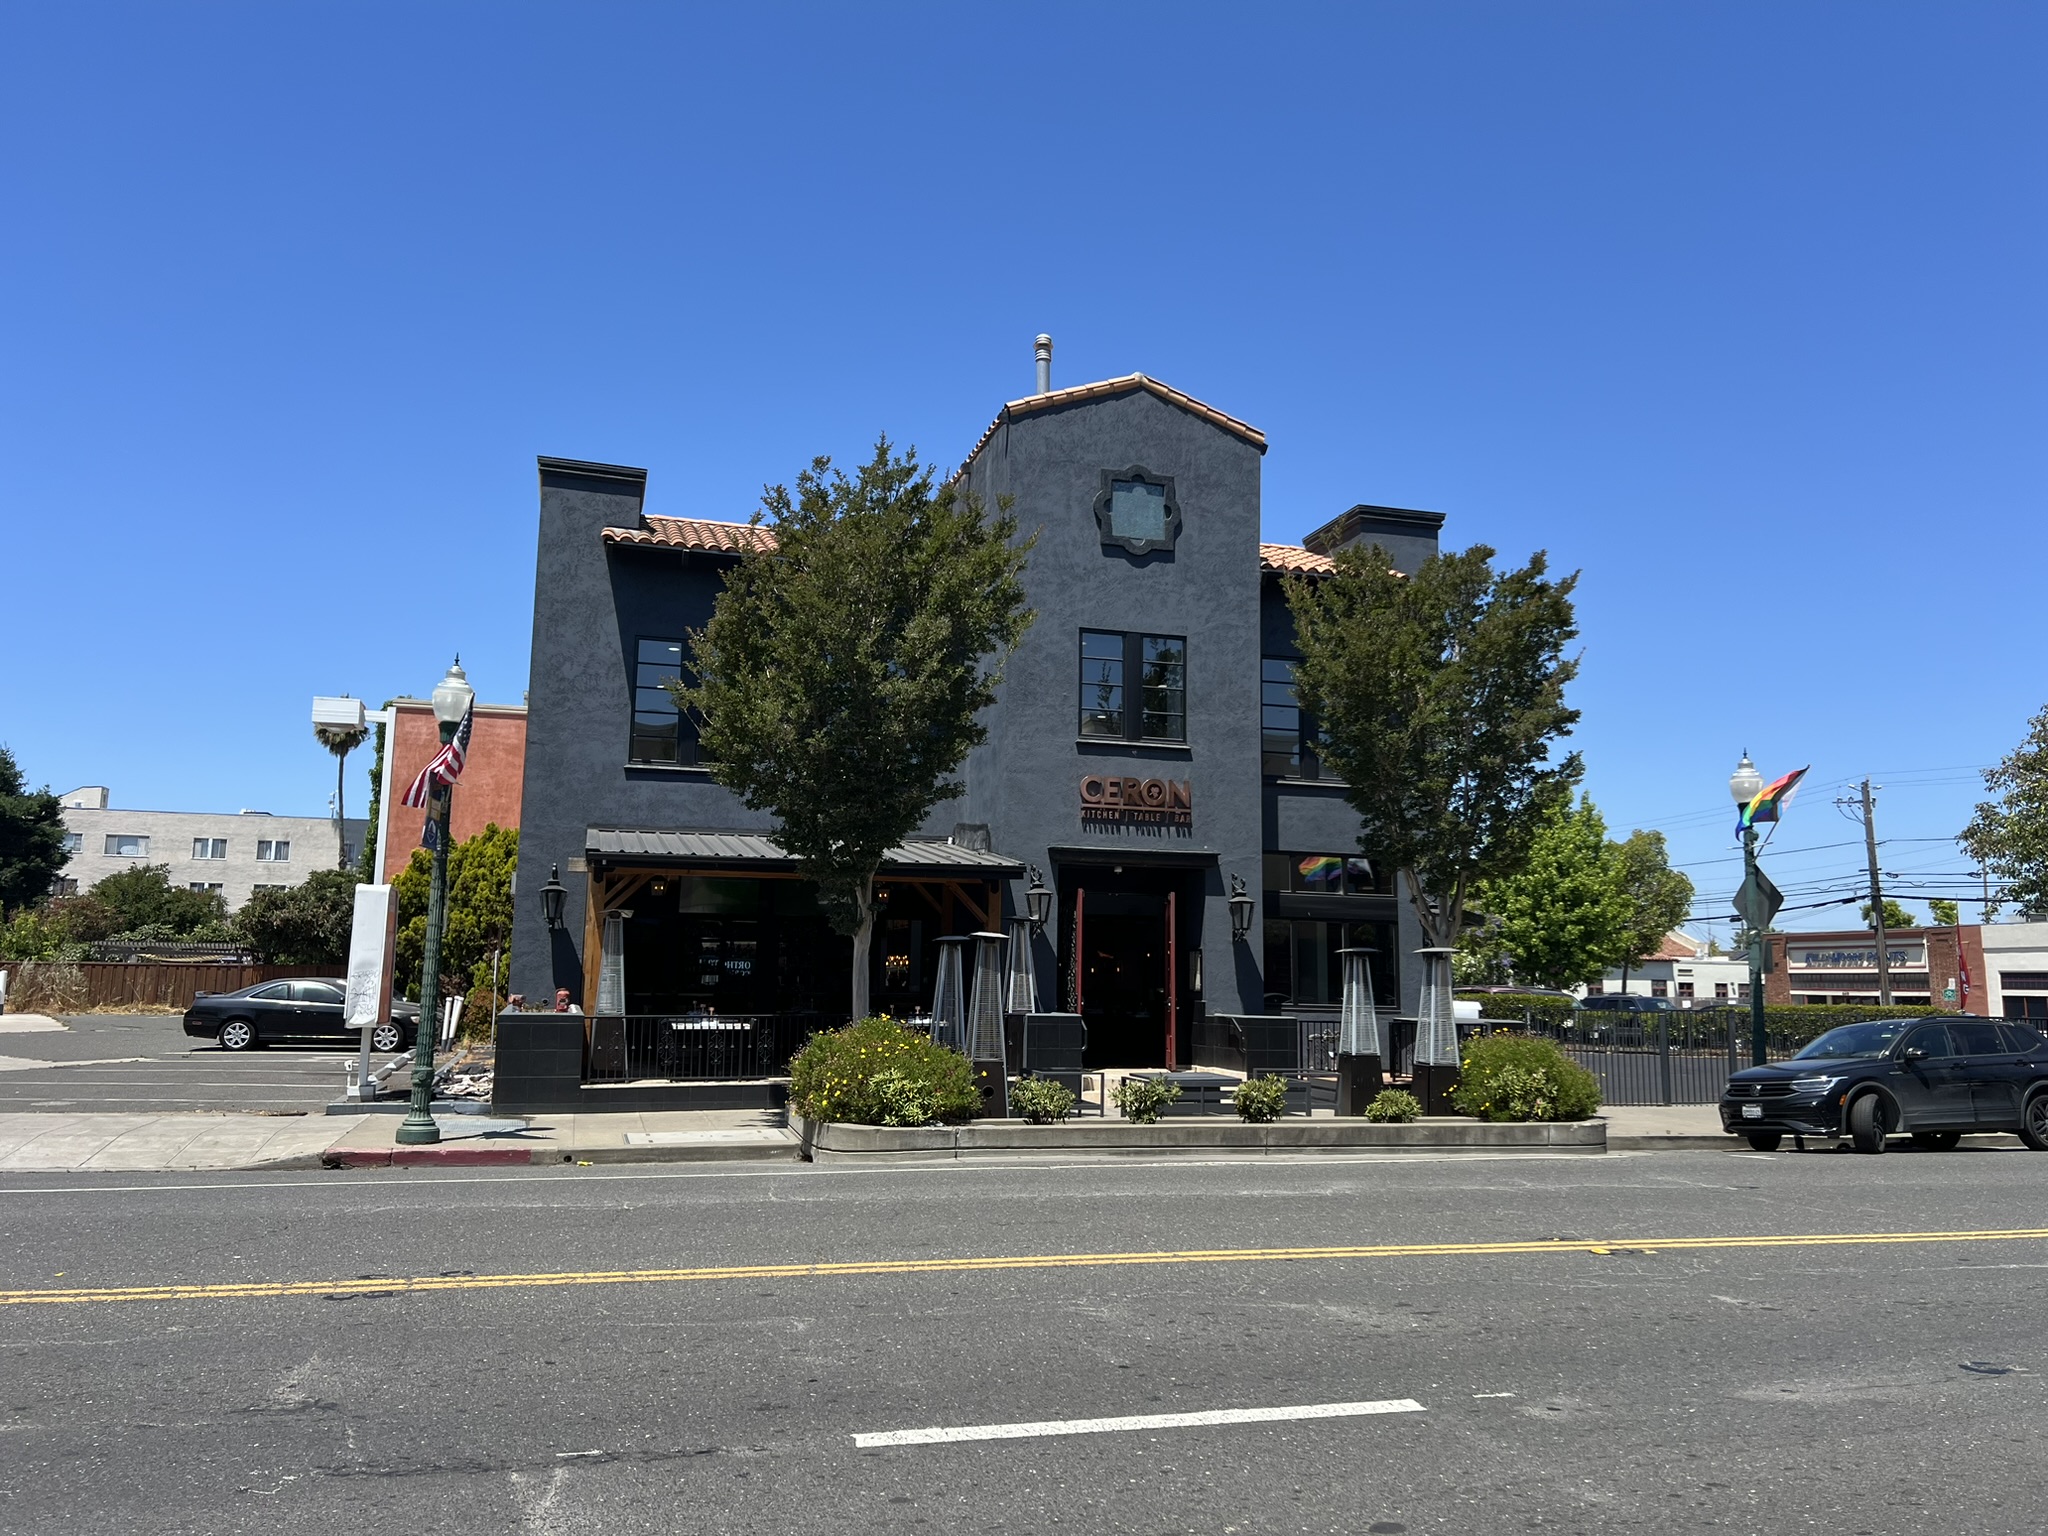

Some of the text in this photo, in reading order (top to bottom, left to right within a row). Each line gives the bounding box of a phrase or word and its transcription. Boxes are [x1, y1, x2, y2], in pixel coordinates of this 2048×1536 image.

[1080, 775, 1192, 807] CERON
[1081, 809, 1192, 824] KITCHEN TABLE BAR
